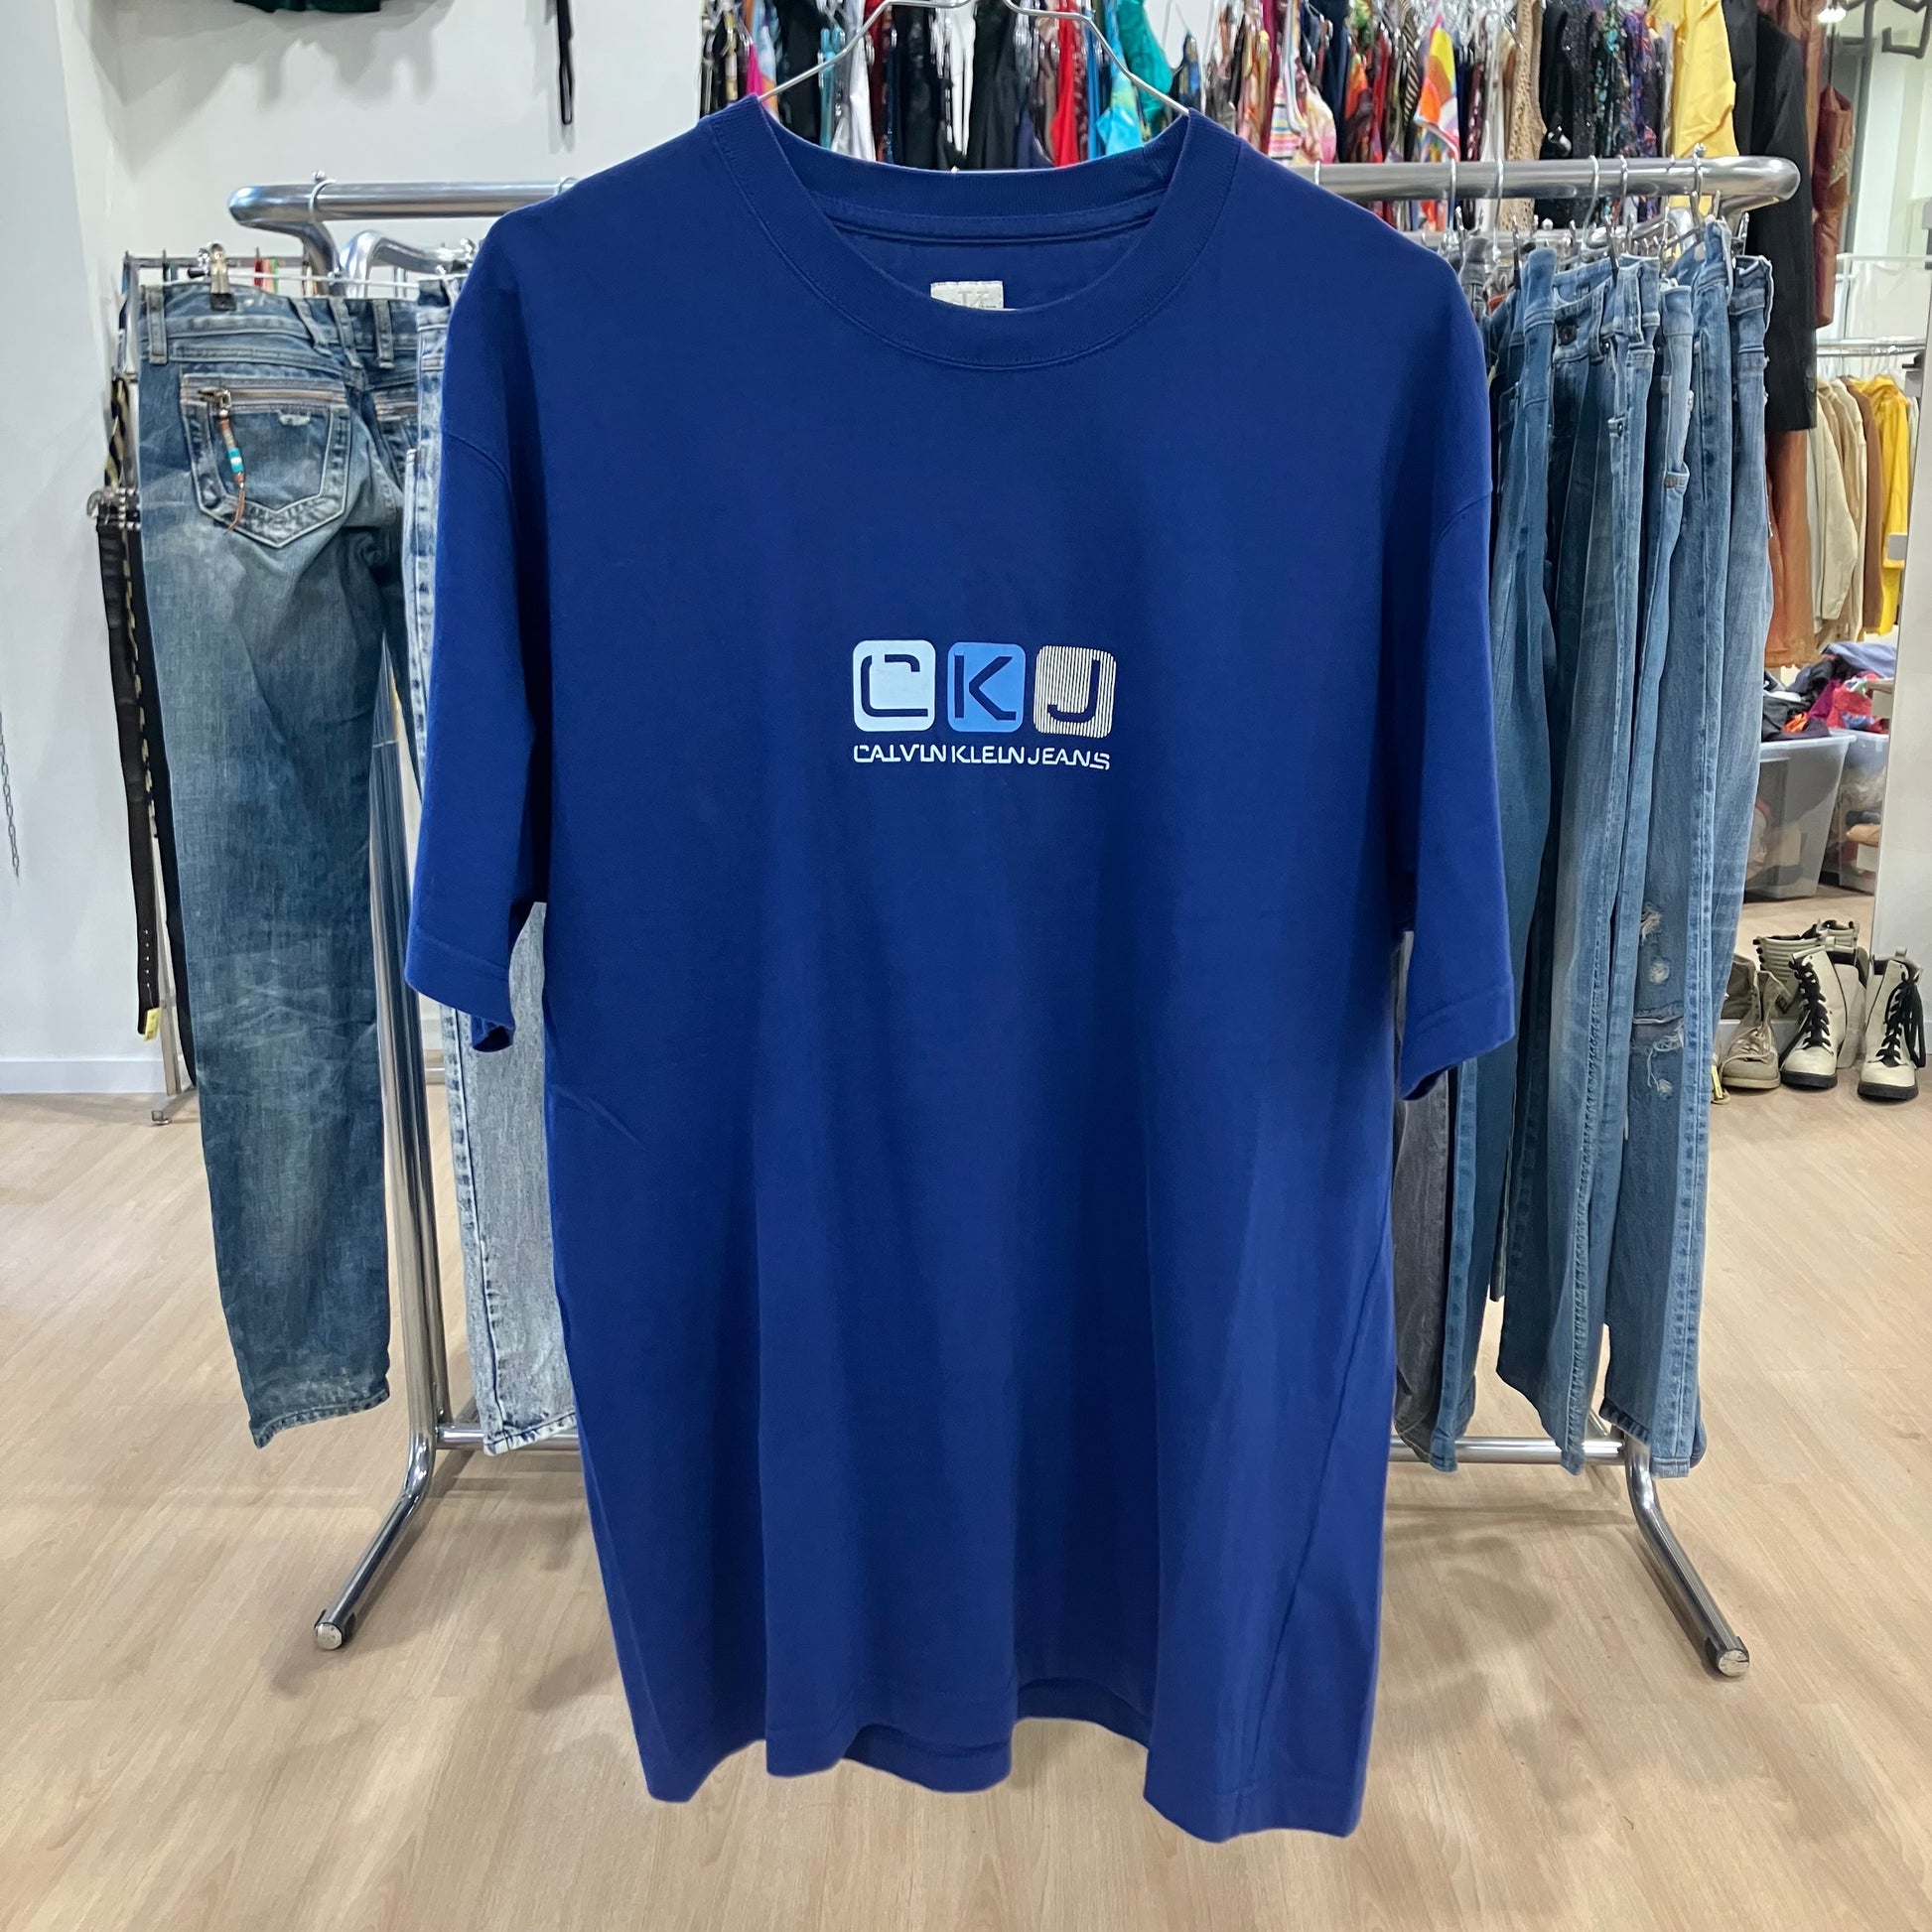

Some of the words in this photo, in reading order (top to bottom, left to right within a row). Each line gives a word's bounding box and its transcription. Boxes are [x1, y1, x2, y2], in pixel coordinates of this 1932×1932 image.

[853, 744, 947, 762] CALVIN
[951, 745, 1026, 764] KLEIN
[1027, 747, 1111, 770] JEANS
